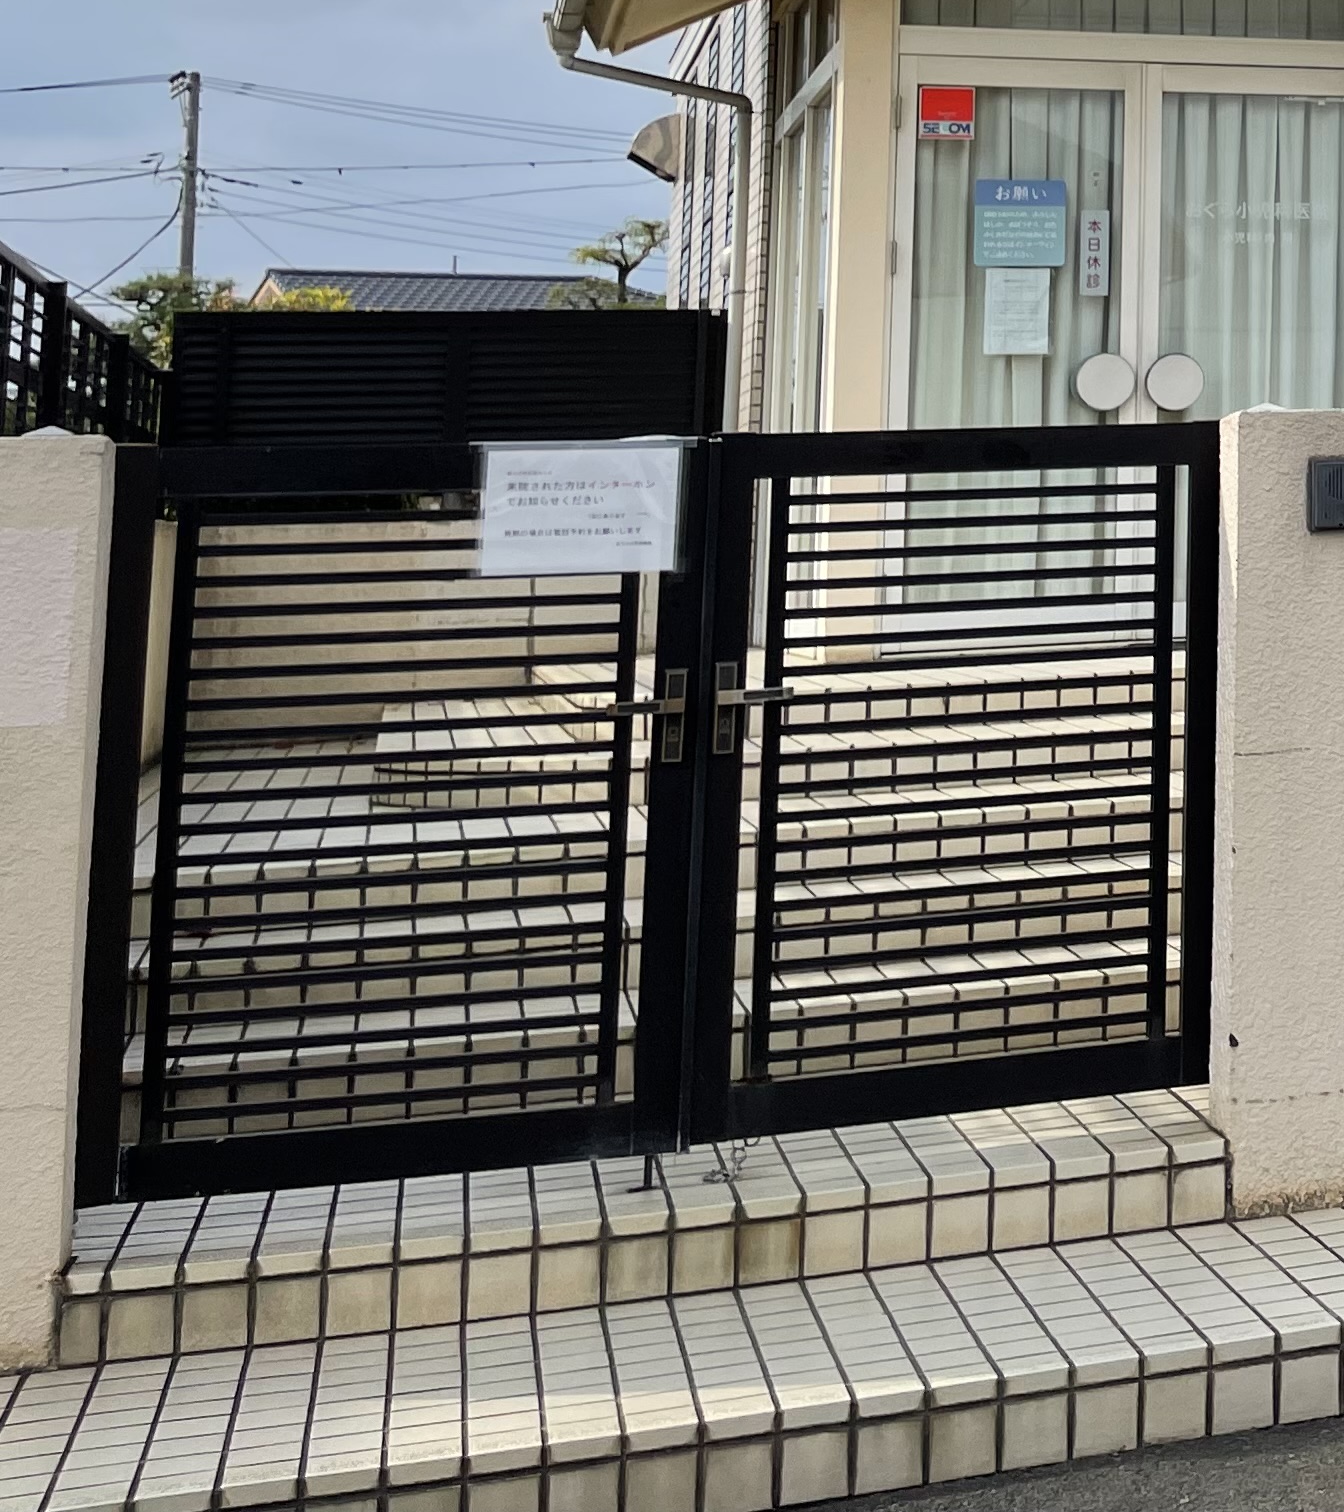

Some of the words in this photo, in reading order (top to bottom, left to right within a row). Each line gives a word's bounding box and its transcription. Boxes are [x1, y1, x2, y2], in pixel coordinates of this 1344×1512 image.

[994, 185, 1048, 202] お願い
[1086, 218, 1102, 289] 本日休診
